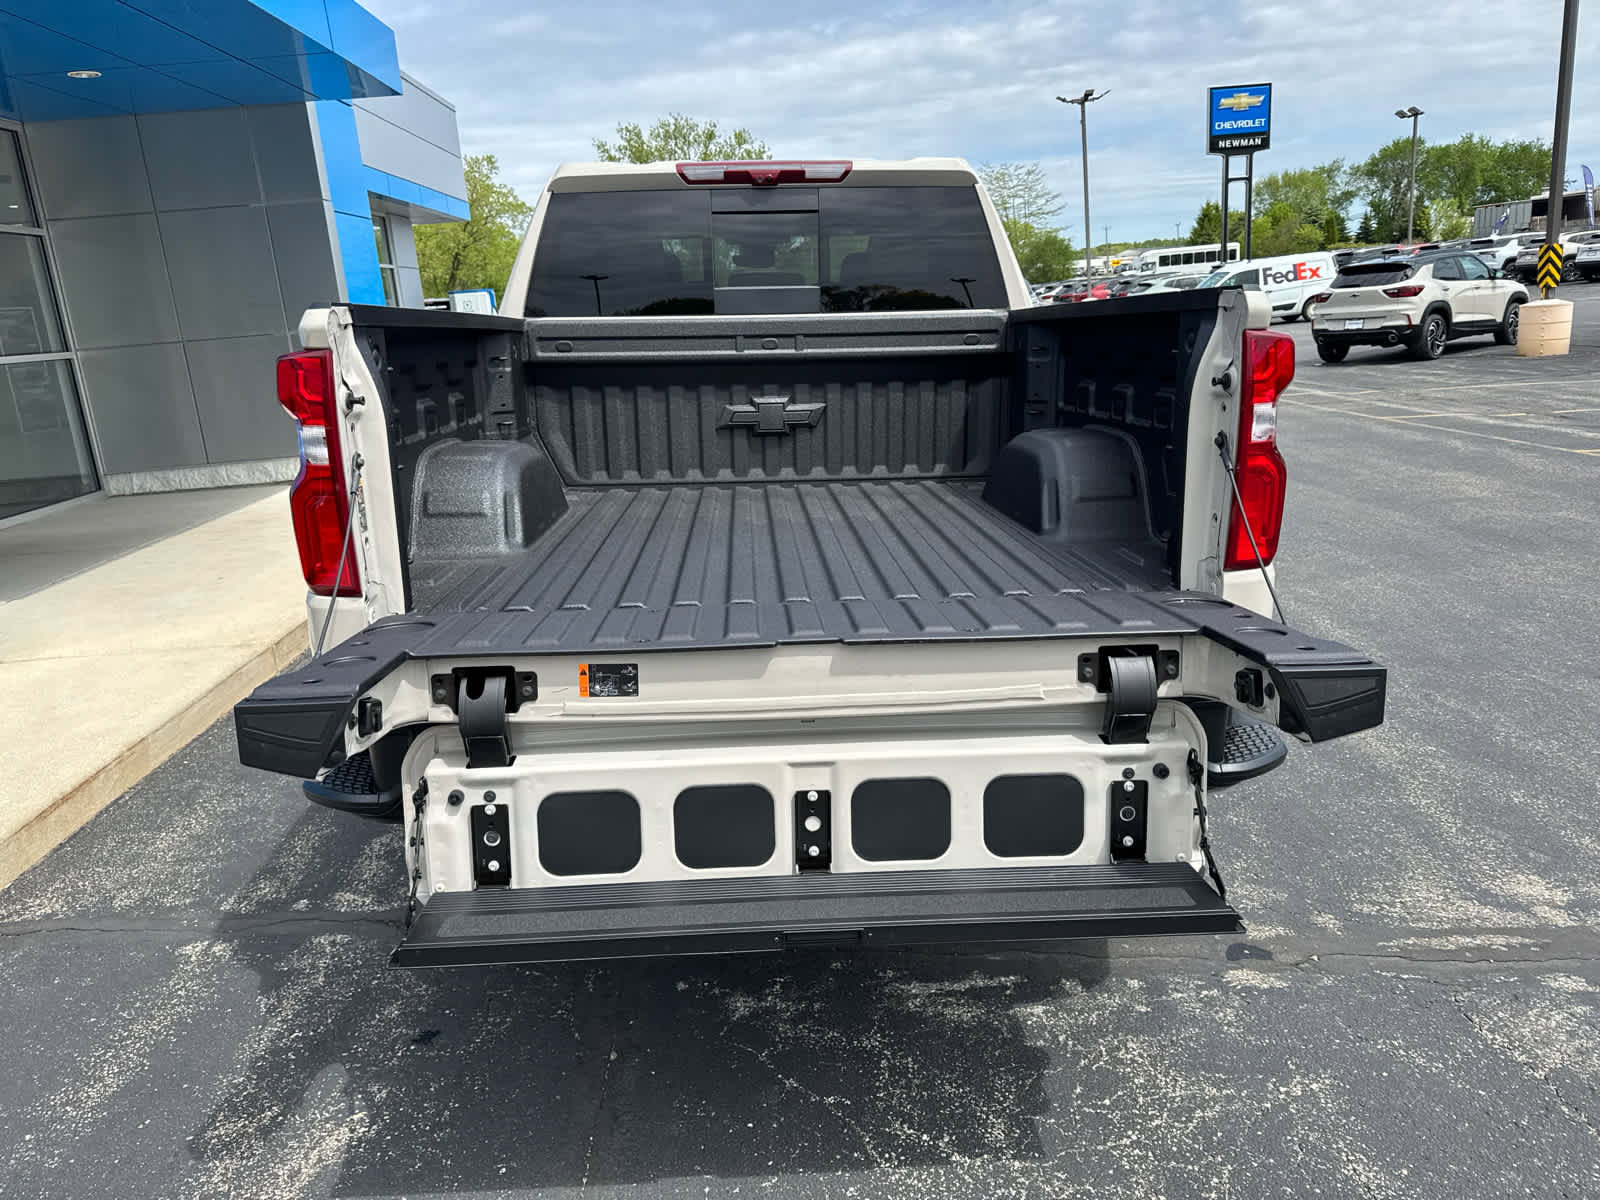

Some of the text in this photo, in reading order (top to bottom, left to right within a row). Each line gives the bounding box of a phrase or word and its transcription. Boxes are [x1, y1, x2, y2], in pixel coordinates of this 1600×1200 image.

[1215, 118, 1266, 130] CHEVROLET
[1218, 138, 1262, 148] NEWMAN
[1262, 261, 1321, 285] FedEx
